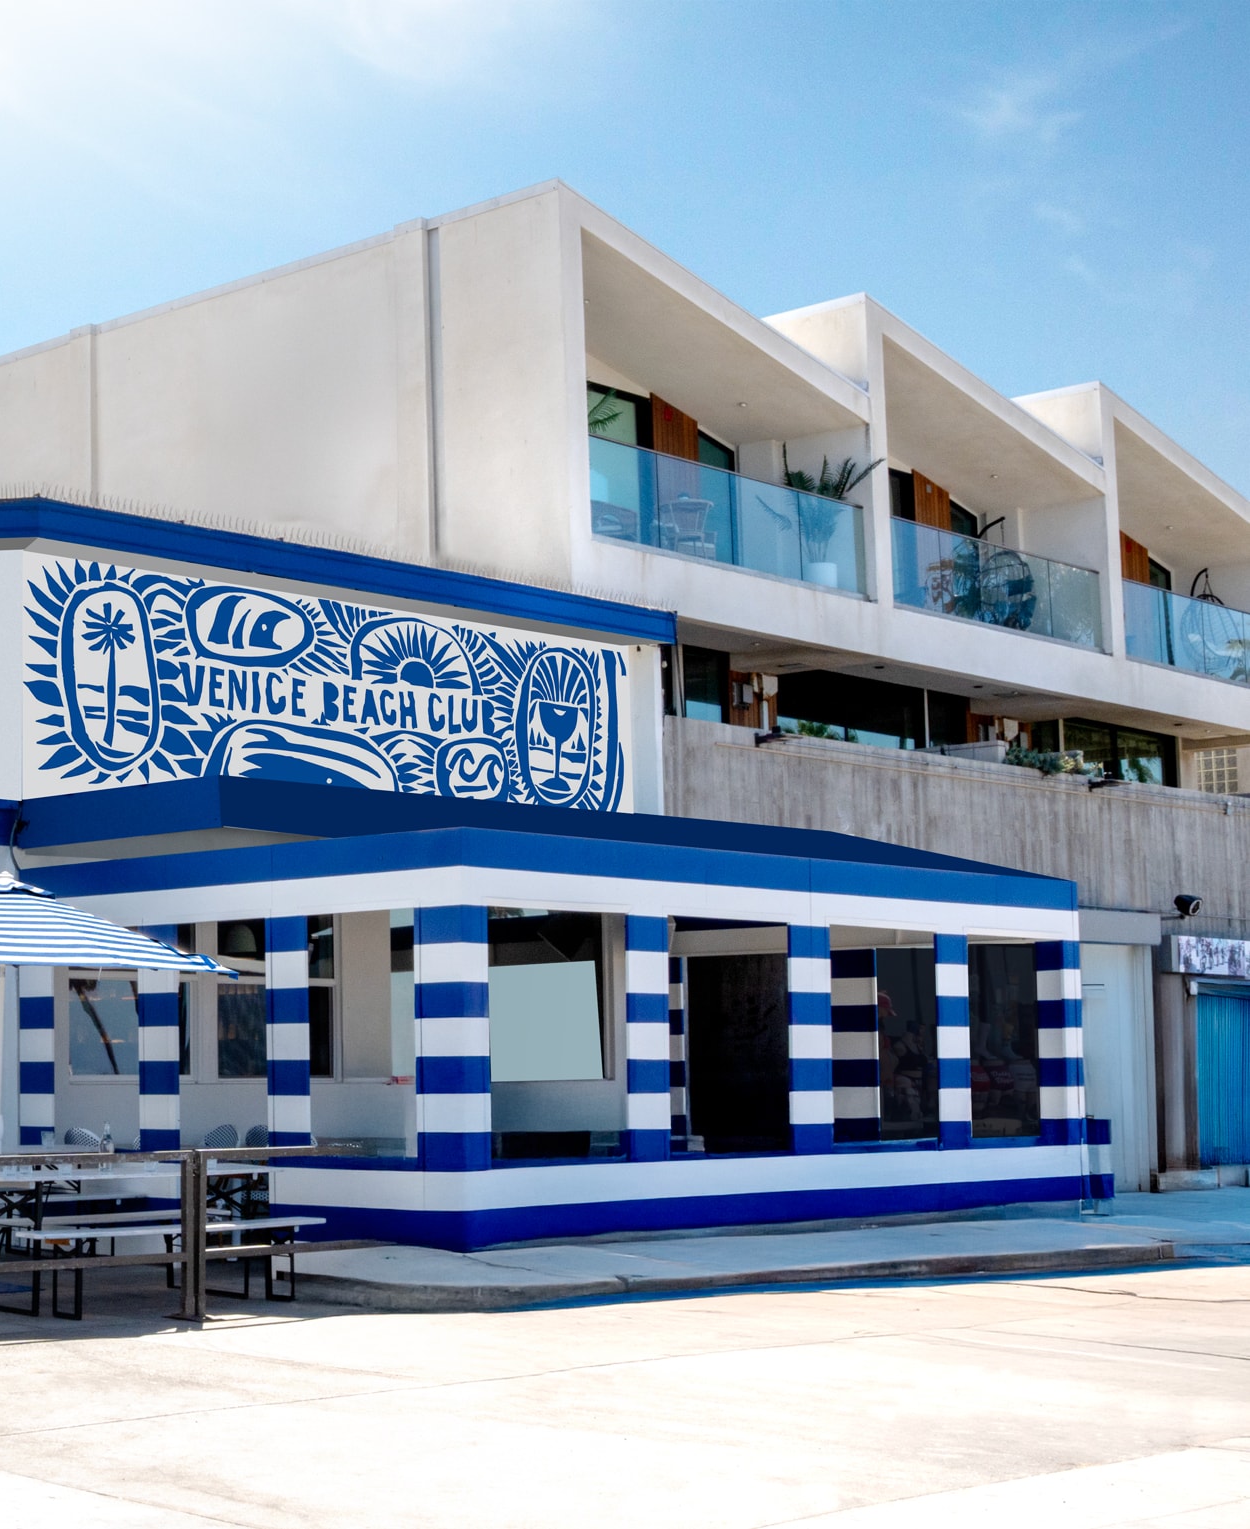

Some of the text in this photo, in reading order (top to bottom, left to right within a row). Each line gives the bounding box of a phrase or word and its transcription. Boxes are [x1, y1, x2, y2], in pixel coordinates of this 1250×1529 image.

[179, 661, 497, 739] VENICE BEACH CLUB
